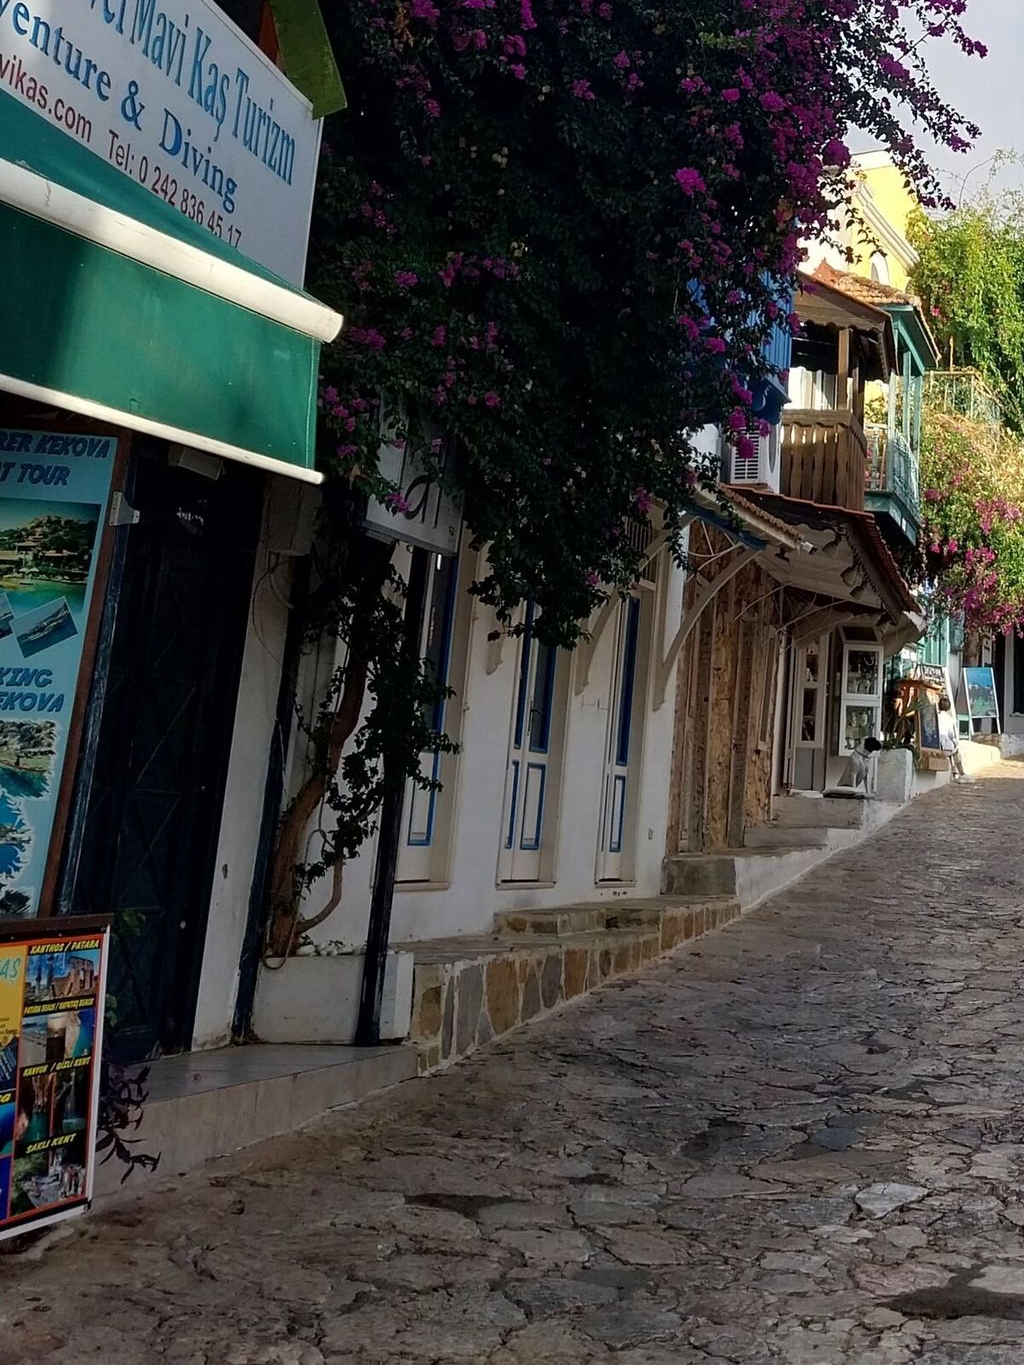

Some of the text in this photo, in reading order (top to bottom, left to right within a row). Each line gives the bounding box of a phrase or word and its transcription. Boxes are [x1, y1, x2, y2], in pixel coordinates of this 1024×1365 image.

[188, 27, 230, 142] Kaş
[232, 67, 295, 185] Turizm
[0, 53, 242, 248] vikas.com Tel: 0 242 836 45 17
[121, 80, 146, 132] &
[159, 107, 238, 214] Diving
[17, 463, 71, 486] TOUR
[34, 436, 111, 458] KEKOVA
[30, 943, 65, 955] XANTHOS
[71, 939, 100, 950] PATARA
